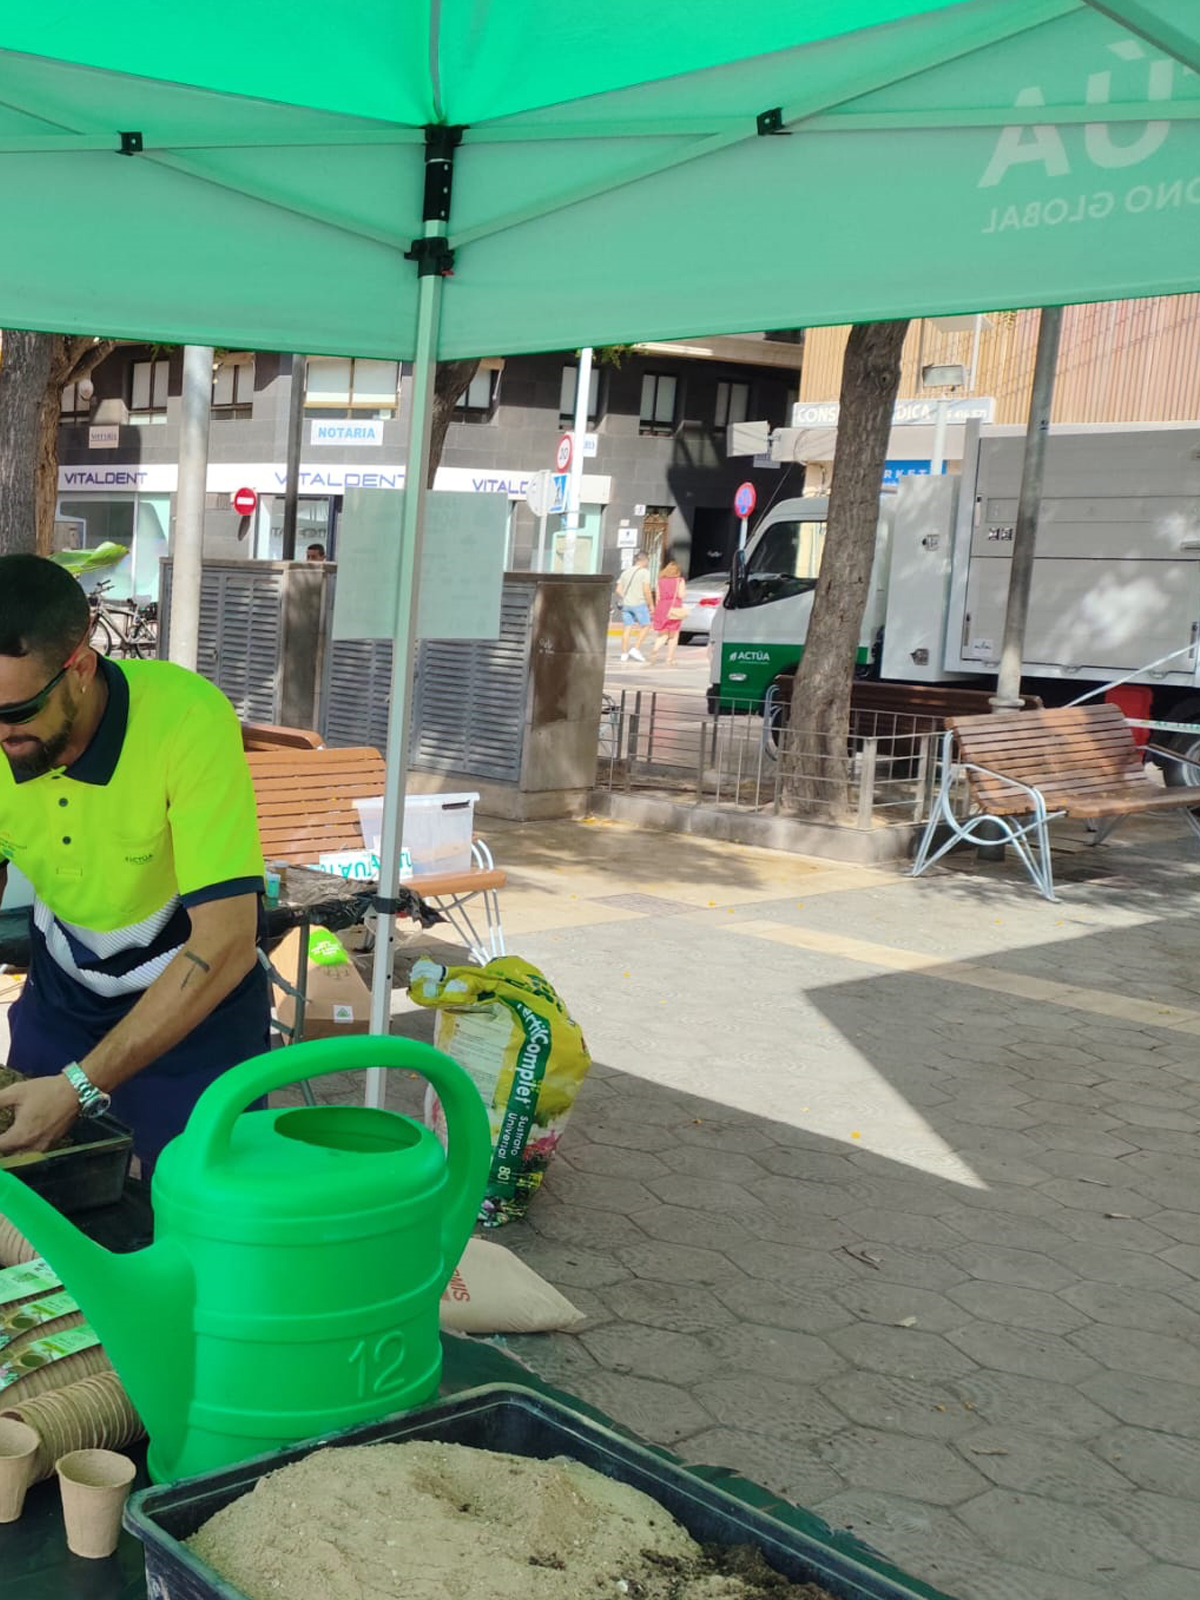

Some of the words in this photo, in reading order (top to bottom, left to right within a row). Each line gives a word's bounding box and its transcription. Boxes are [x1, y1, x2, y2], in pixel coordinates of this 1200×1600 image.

[318, 427, 376, 439] NOTARIA
[64, 472, 148, 485] VITALDENT
[497, 1112, 518, 1159] Universal
[510, 1115, 529, 1156] Sustrato
[349, 1330, 405, 1398] 12
